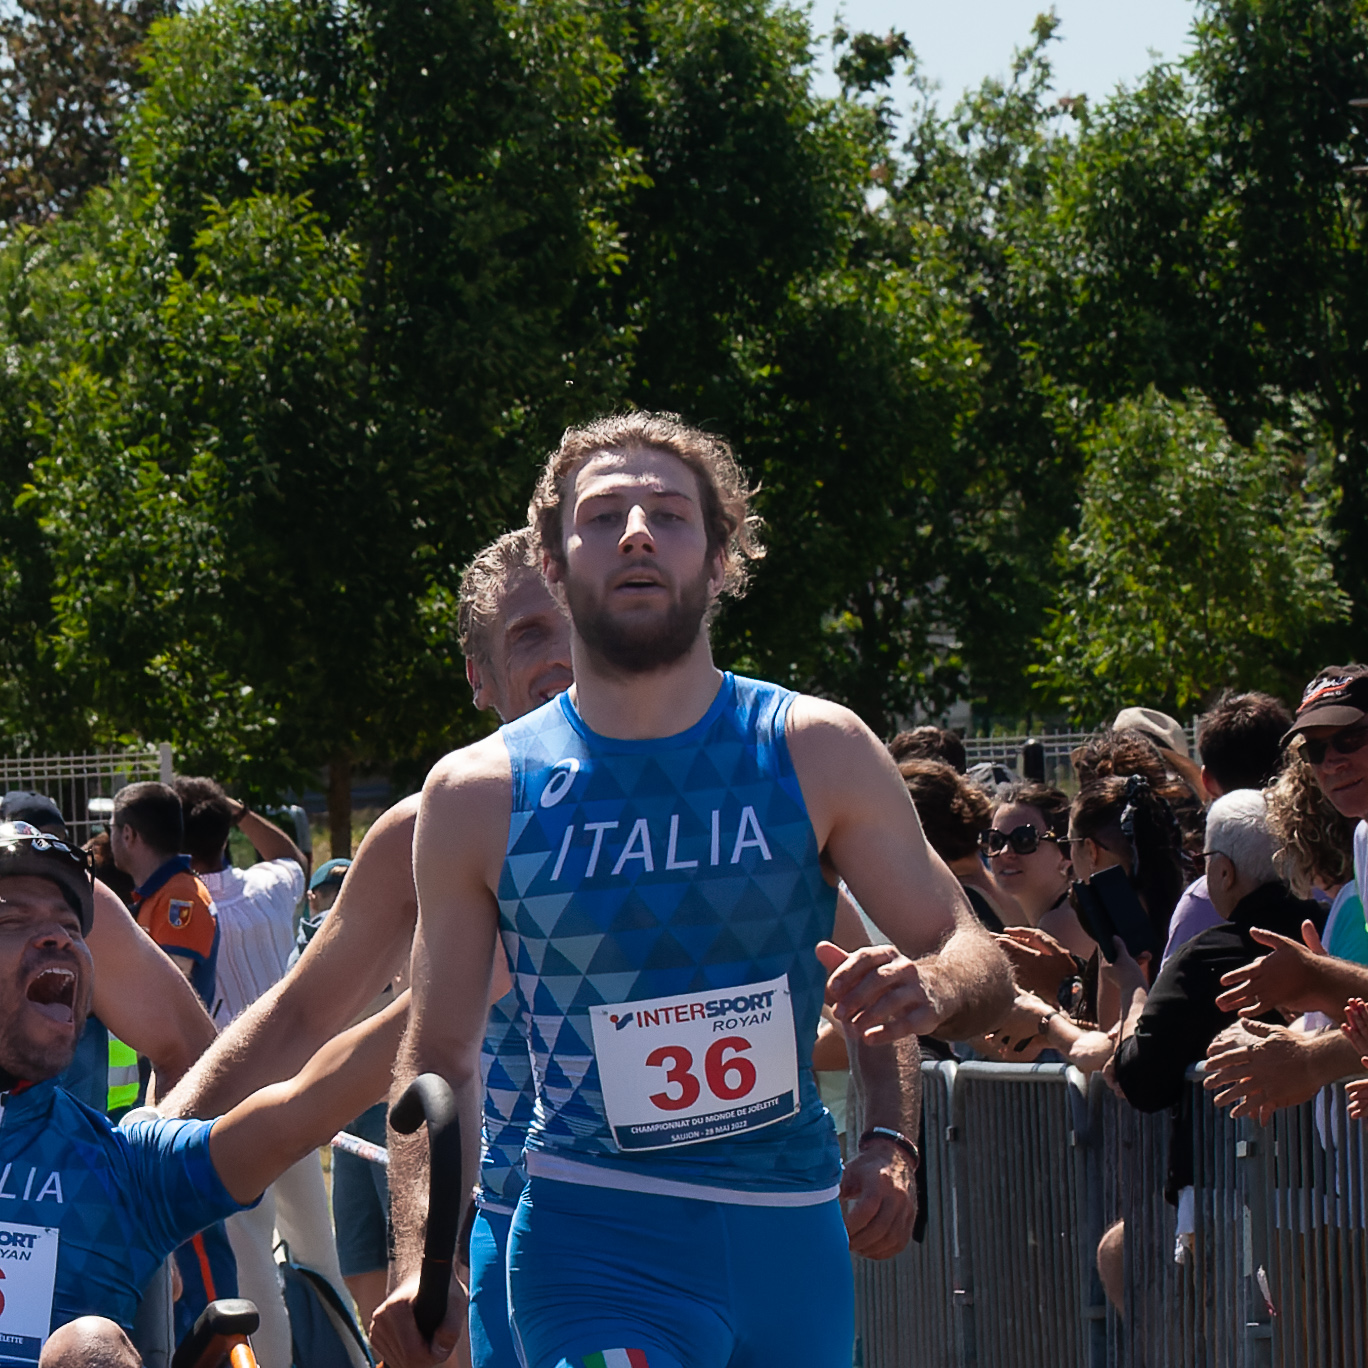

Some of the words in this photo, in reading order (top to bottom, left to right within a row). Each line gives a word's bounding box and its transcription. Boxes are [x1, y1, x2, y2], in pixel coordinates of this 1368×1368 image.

[550, 806, 772, 881] ITALIA
[636, 990, 774, 1028] INTERSPORT
[712, 1011, 772, 1032] ROYAN
[645, 1036, 757, 1111] 36
[631, 1119, 691, 1134] CHAMPIONNAT
[691, 1117, 704, 1126] DU
[705, 1110, 736, 1123] MONDE
[736, 1107, 747, 1117] DE
